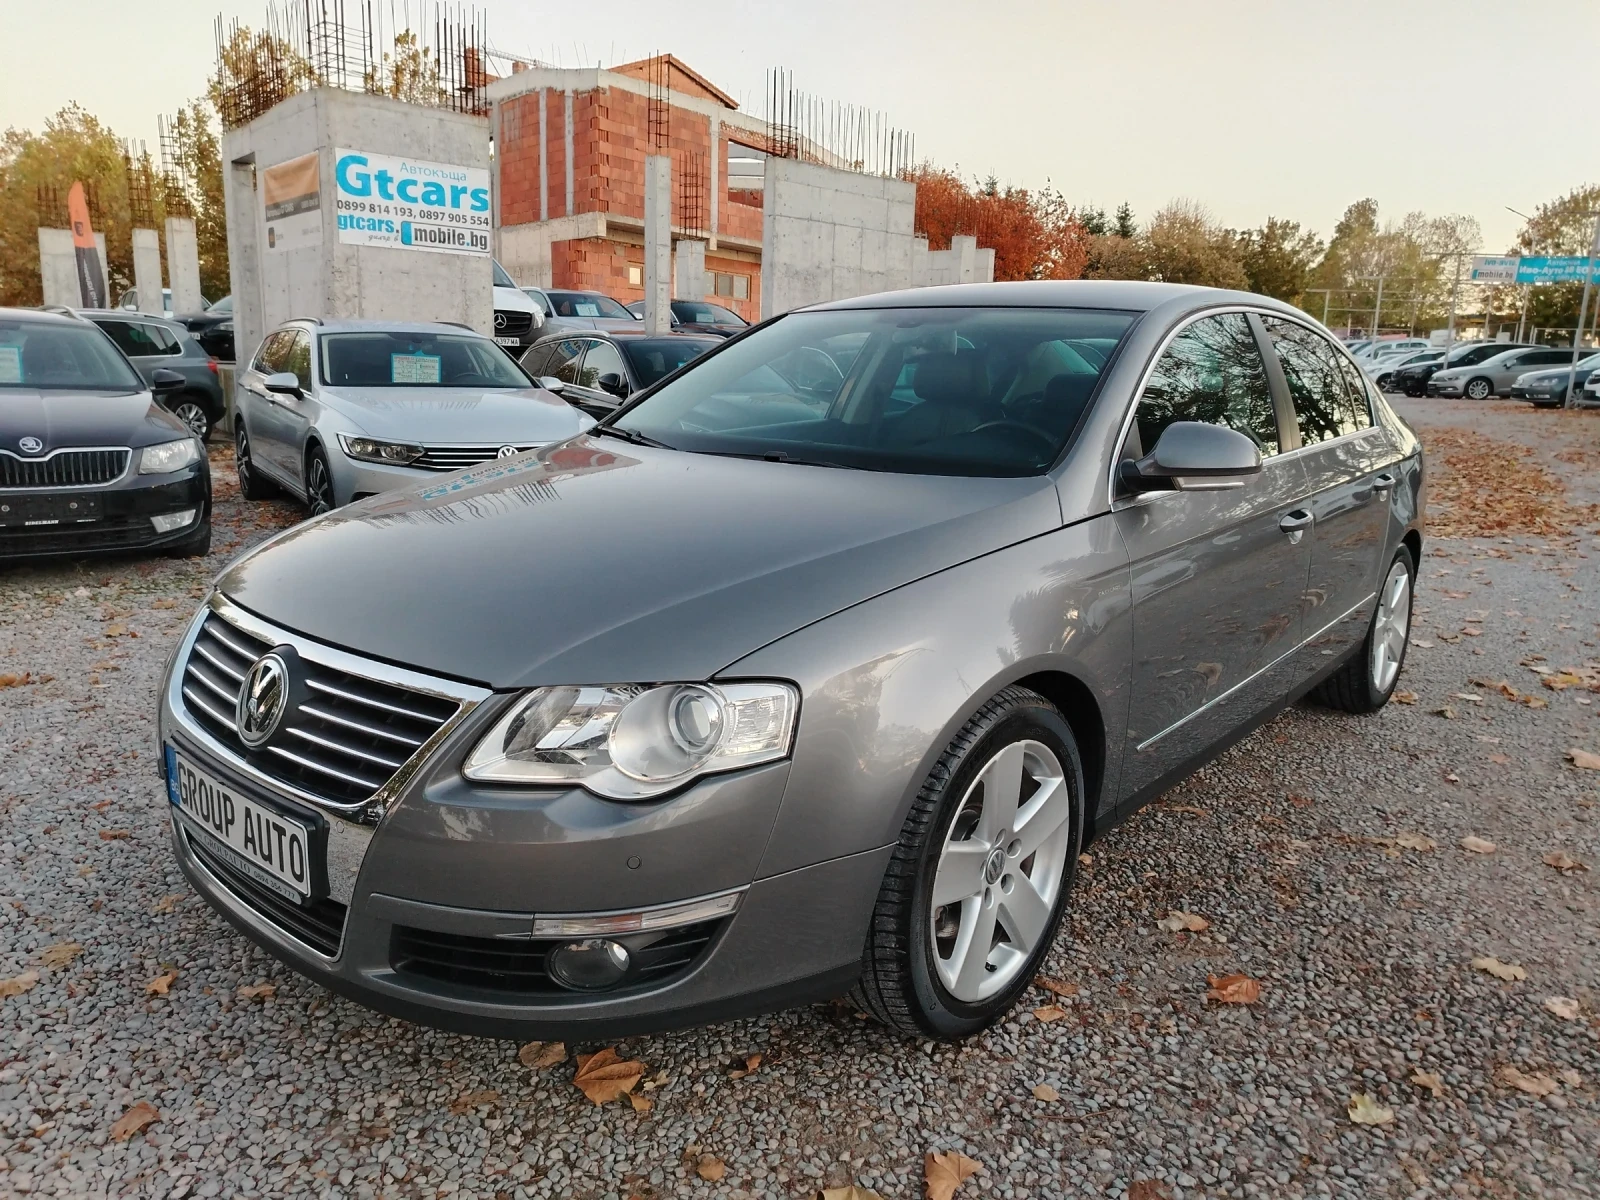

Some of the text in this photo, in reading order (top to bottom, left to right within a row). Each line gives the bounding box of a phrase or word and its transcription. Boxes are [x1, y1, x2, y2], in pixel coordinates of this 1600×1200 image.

[335, 155, 489, 212] Gtcars
[400, 162, 467, 182] Автокъща
[337, 200, 489, 226] 0899 814 193, 0897 905 554
[337, 214, 399, 234] gtcars.
[414, 227, 488, 250] mobile.bg
[178, 761, 235, 838] GROUP
[244, 806, 305, 883] AUTO
